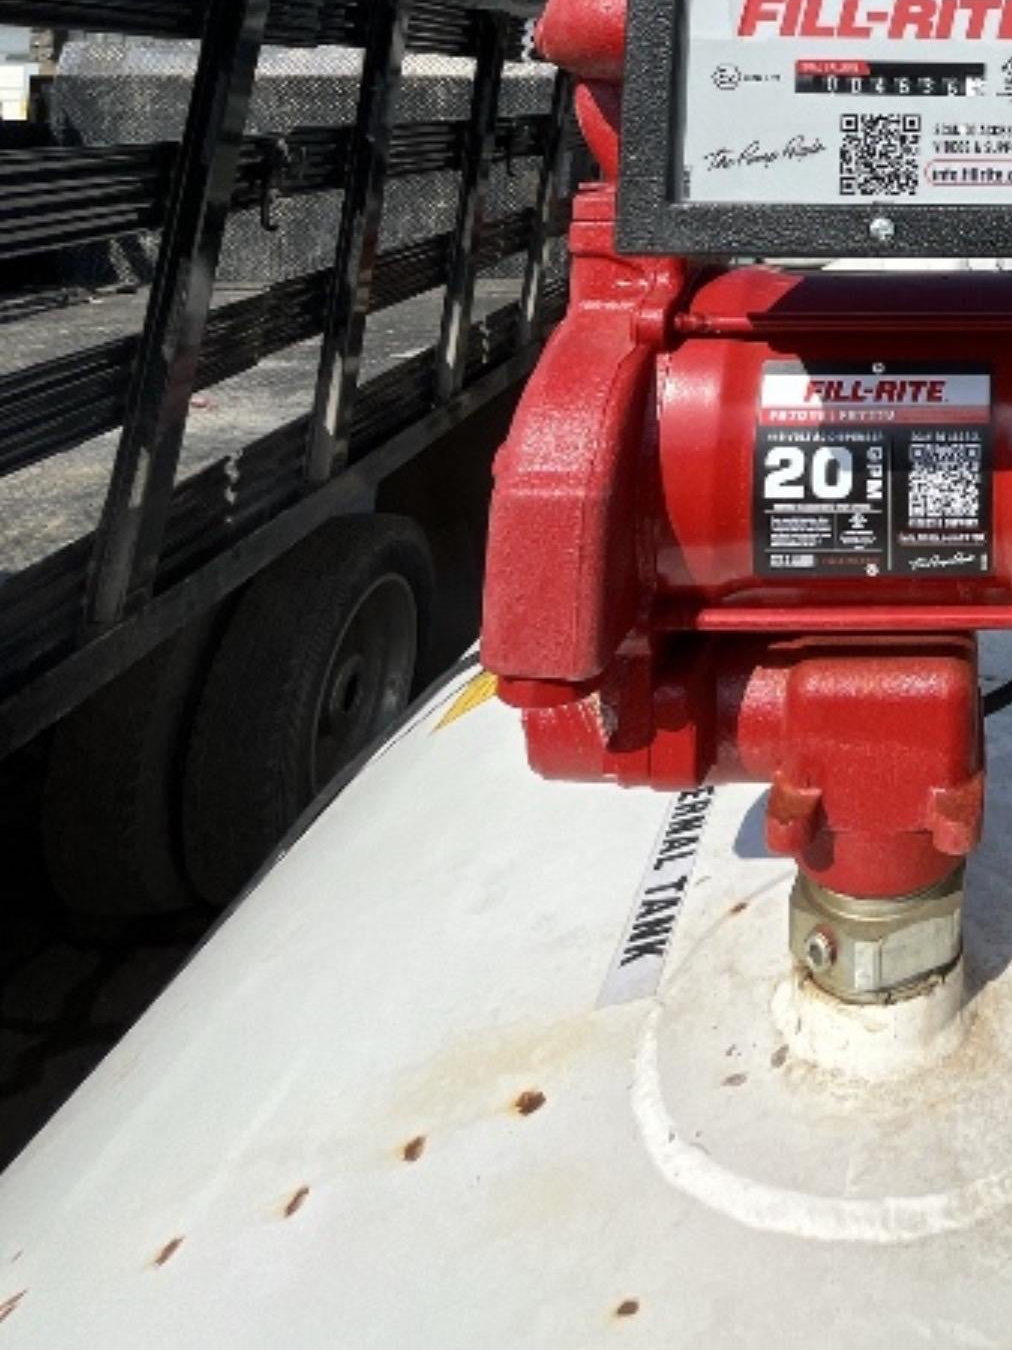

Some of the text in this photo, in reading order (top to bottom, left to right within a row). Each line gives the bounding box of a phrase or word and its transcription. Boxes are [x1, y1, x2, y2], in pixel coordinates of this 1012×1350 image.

[803, 380, 946, 403] FILL-RITE
[763, 446, 854, 499] 20
[866, 446, 883, 500] GPM
[619, 875, 689, 968] TANK
